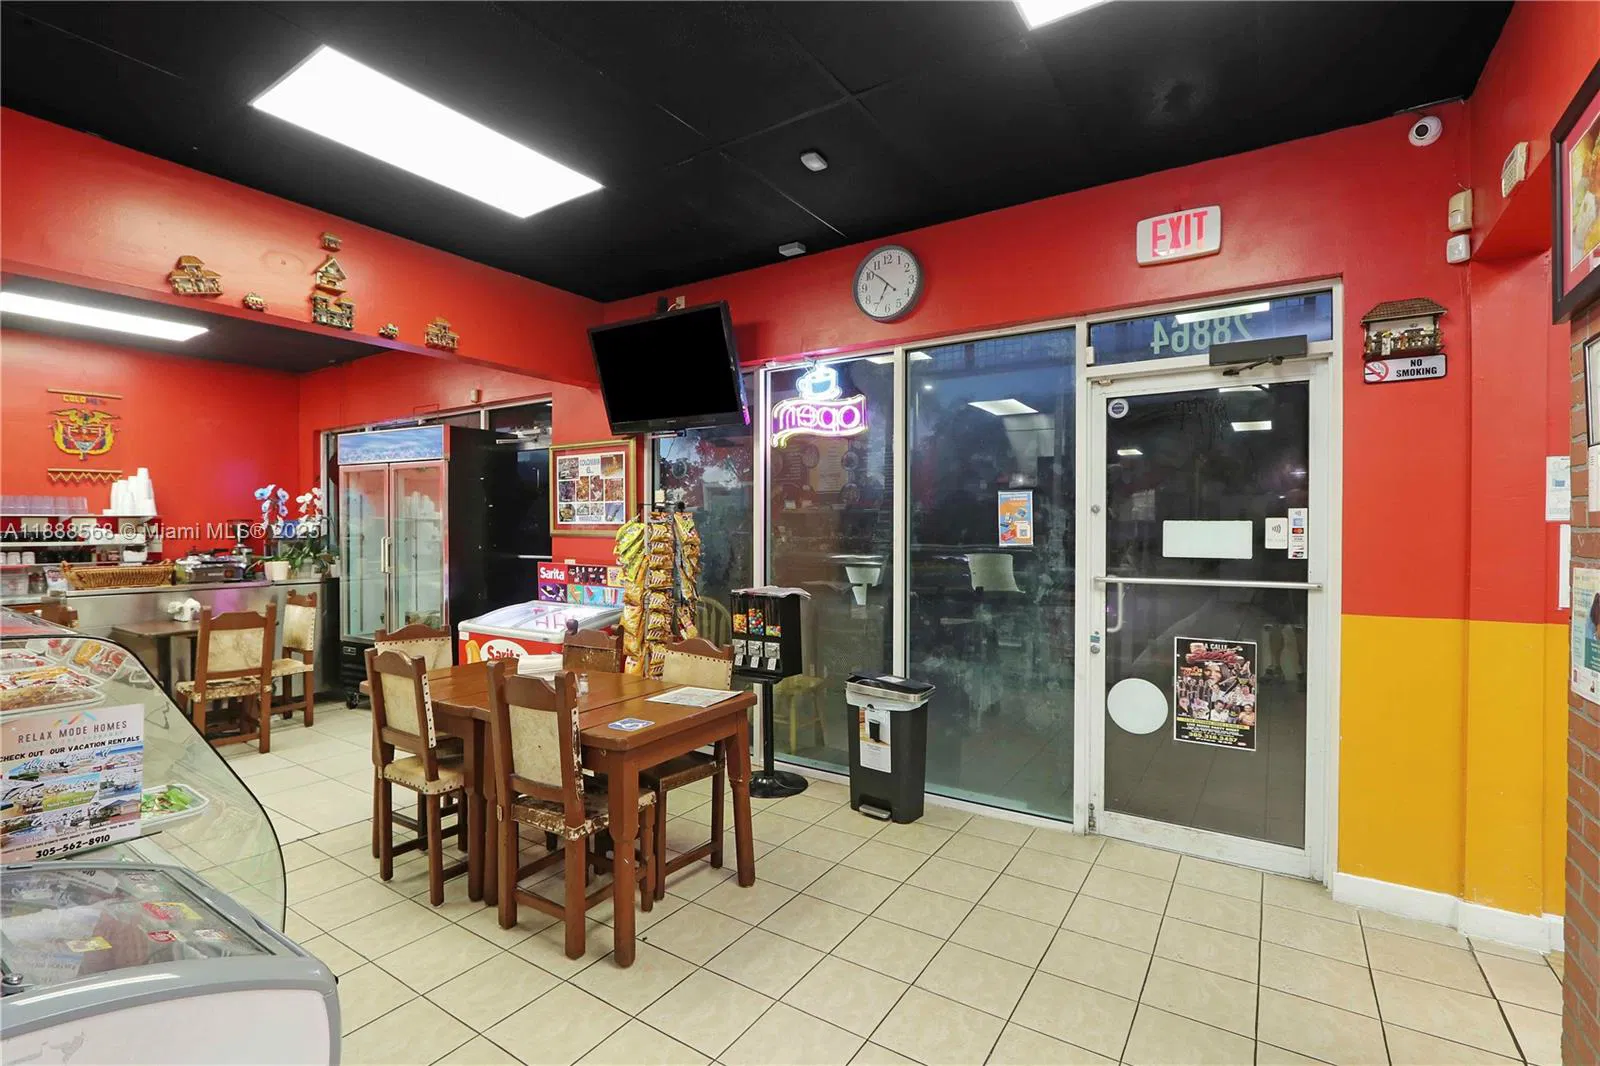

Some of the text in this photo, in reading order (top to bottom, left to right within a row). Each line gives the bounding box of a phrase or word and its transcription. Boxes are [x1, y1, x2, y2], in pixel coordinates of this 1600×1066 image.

[1152, 210, 1208, 257] EXIT
[883, 254, 893, 265] 12
[896, 255, 901, 264] 1
[873, 260, 880, 271] 11
[903, 262, 911, 273] 2
[866, 271, 875, 281] 10
[908, 274, 915, 285] 3
[861, 283, 868, 293] 9
[903, 287, 910, 297] 4
[865, 295, 871, 304] 8
[873, 302, 880, 312] 7
[884, 303, 891, 313] 6
[1410, 358, 1423, 367] NO
[1396, 366, 1437, 378] SMOKING
[540, 566, 565, 580] Sarita
[17, 731, 53, 744] RELAX
[59, 725, 88, 739] MODE
[93, 720, 127, 733] HOMES
[28, 750, 44, 758] OUT
[49, 747, 65, 755] OUR
[68, 740, 106, 752] VACATION
[107, 735, 140, 745] RENTALS
